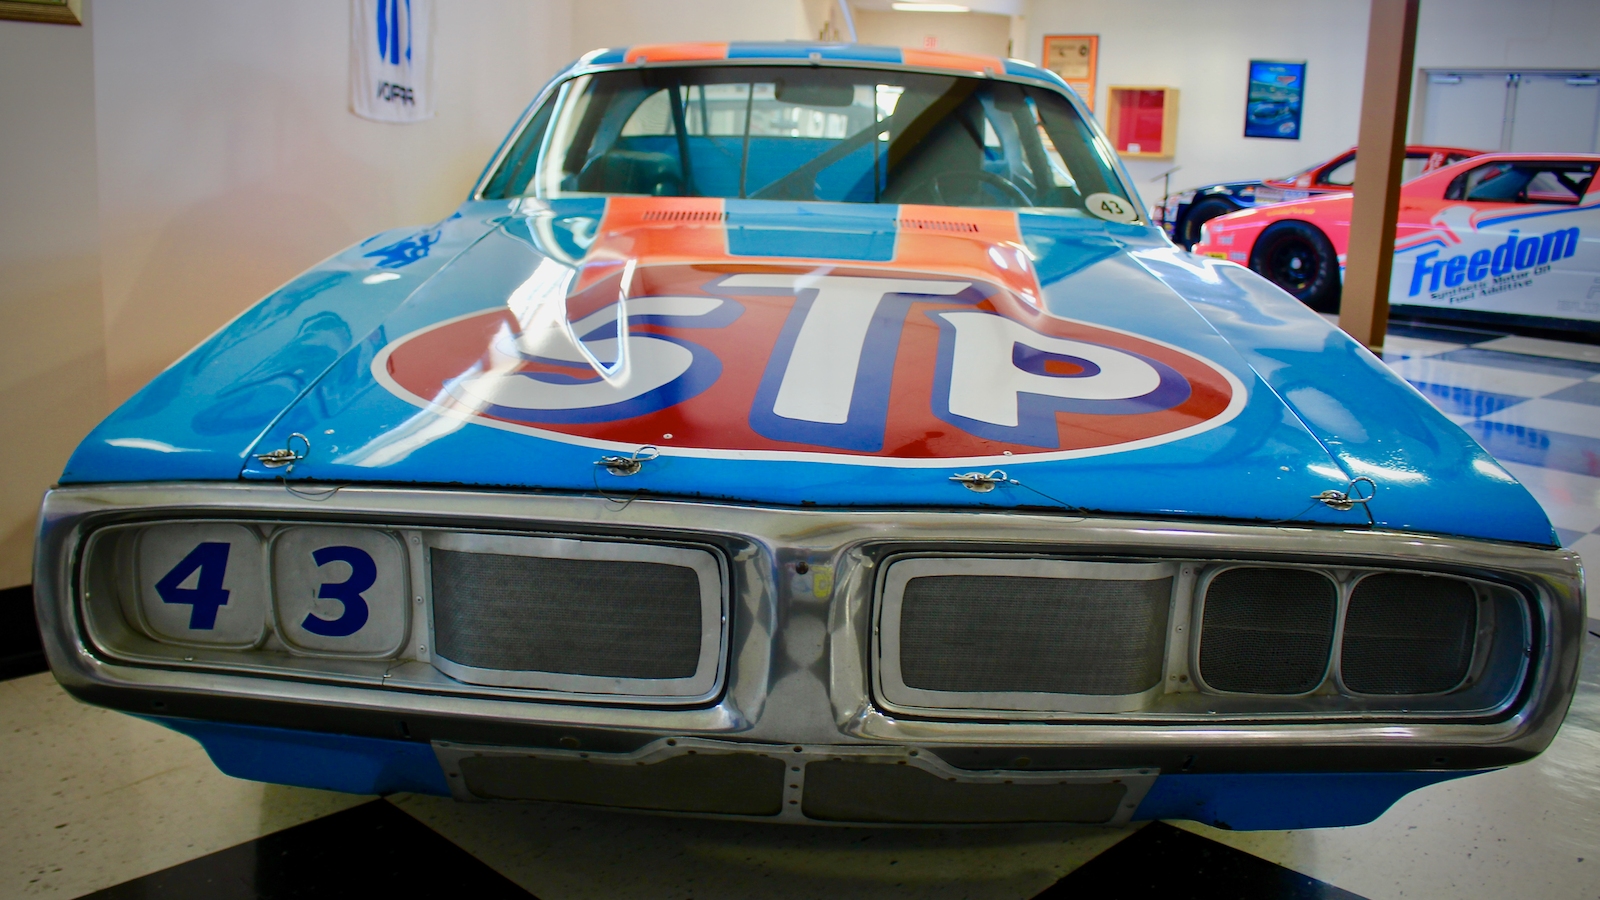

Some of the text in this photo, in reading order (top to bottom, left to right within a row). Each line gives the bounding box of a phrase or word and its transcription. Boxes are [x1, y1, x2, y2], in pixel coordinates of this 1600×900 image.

[1101, 200, 1124, 214] 43
[1409, 227, 1580, 297] Freedom
[1430, 281, 1489, 300] Synthetic
[1493, 270, 1531, 285] Motor
[1449, 278, 1534, 304] Fuel Additive
[443, 272, 1191, 452] STP
